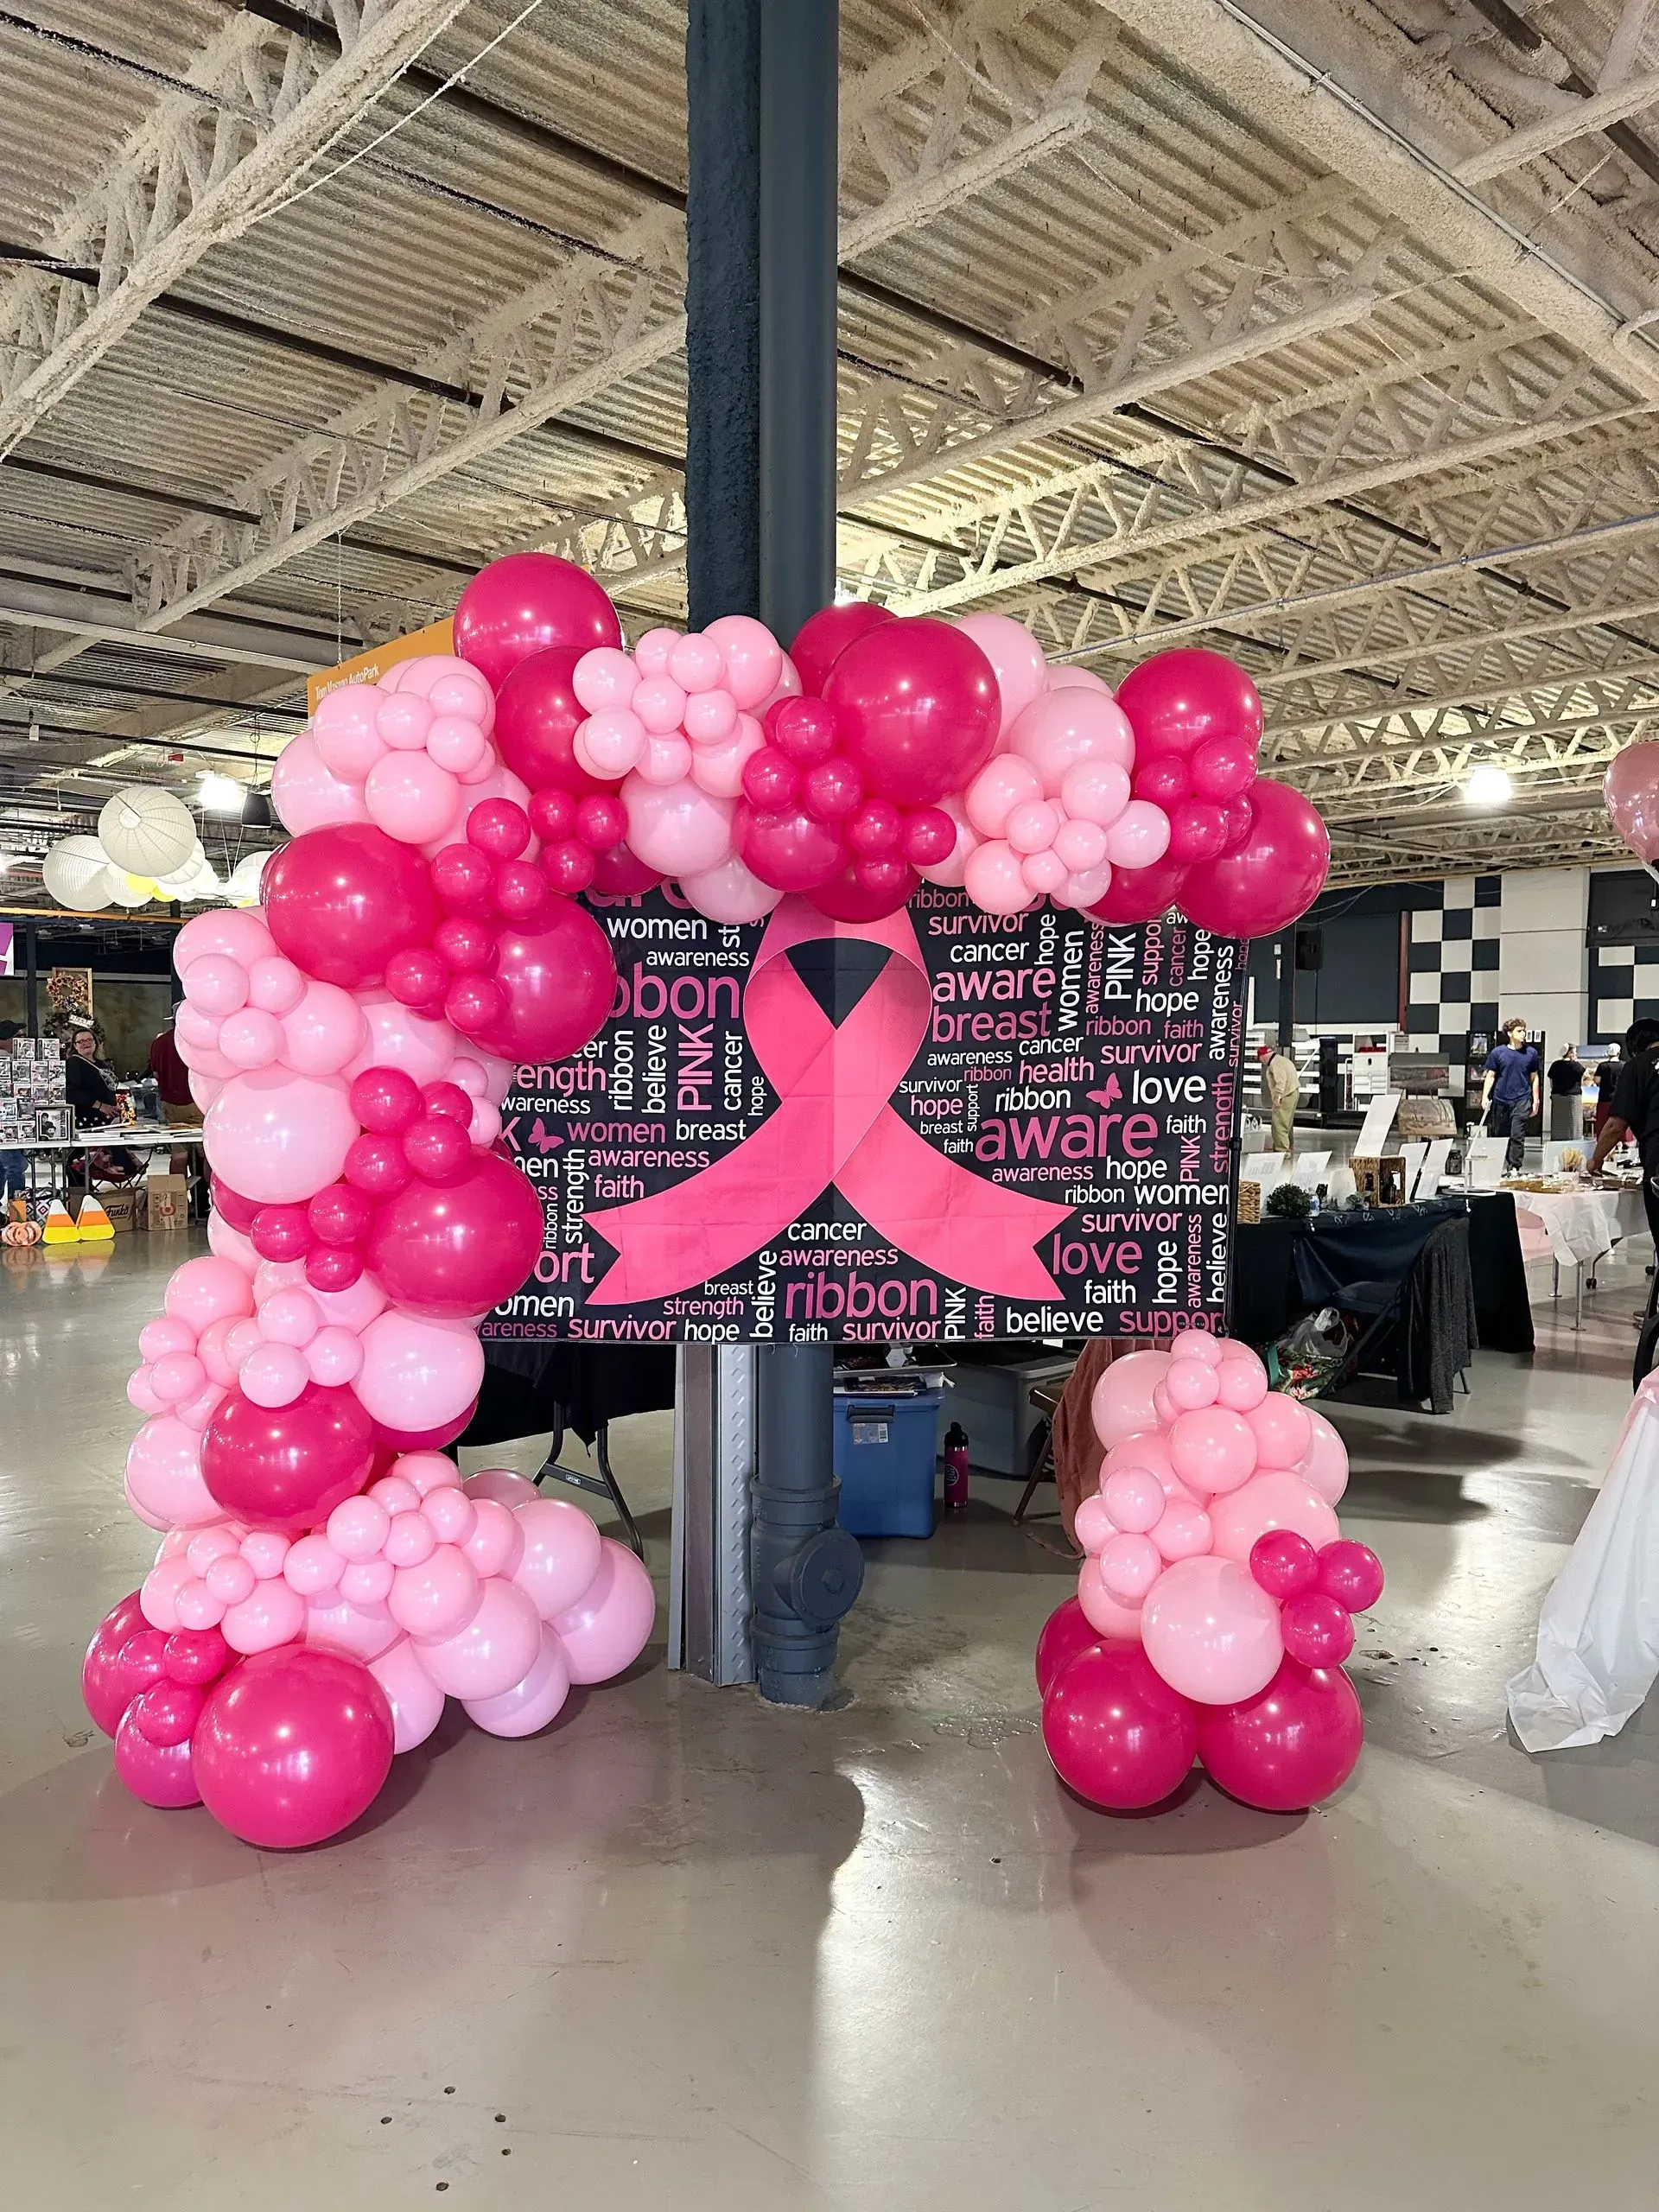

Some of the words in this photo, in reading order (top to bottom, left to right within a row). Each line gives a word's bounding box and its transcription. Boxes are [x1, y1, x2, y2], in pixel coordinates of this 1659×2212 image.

[348, 664, 378, 684] AutoPark
[909, 889, 969, 908] ribbon
[607, 918, 708, 940] women
[928, 913, 1029, 935] survivor
[950, 940, 1029, 963] cancer
[1034, 914, 1059, 965] hope
[646, 950, 750, 967] awareness
[1104, 931, 1137, 1000] PINK
[1169, 926, 1187, 987] cancer
[1187, 929, 1215, 980] hope
[1058, 930, 1084, 1032] women
[1085, 923, 1104, 1014] awareness
[607, 962, 740, 1020] bbon
[932, 966, 1056, 1002] aware
[1135, 988, 1199, 1016] hope
[1209, 945, 1234, 1061] awareness
[932, 1001, 1052, 1043] breast
[1085, 1016, 1151, 1036] ribbon
[1163, 1020, 1204, 1039] faith
[1229, 1001, 1243, 1067] survivor
[927, 1049, 1013, 1066] awareness
[1019, 1037, 1084, 1056] cancer
[1101, 1039, 1203, 1065] survivor
[513, 1060, 607, 1097] ength
[608, 1030, 634, 1109] ribbon
[642, 1025, 667, 1113] believe
[677, 1023, 714, 1111] PINK
[724, 1030, 743, 1111] cancer
[964, 1066, 1011, 1082] ribbon
[1019, 1056, 1094, 1084] health
[748, 1076, 767, 1116] hope
[899, 1077, 963, 1094] survivor
[1132, 1070, 1206, 1104] love
[501, 1097, 591, 1115] wareness
[911, 1095, 963, 1120] hope
[966, 1084, 980, 1132] support
[995, 1085, 1071, 1113] ribbon
[567, 1122, 665, 1143] women
[676, 1119, 747, 1141] breast
[920, 1120, 963, 1135] breast
[1166, 1115, 1206, 1135] faith
[1210, 1071, 1234, 1173] strength
[944, 1138, 973, 1154] faith
[975, 1112, 1158, 1161] aware
[588, 1147, 710, 1168] awareness
[1106, 1155, 1167, 1181] hope
[1180, 1135, 1201, 1182] PINK
[594, 1173, 644, 1198] faith
[992, 1165, 1093, 1182] awareness
[562, 1148, 589, 1244] strength
[1065, 1184, 1125, 1204] ribbon
[1134, 1183, 1229, 1205] women
[543, 1203, 558, 1249] ribbon
[788, 1221, 867, 1241] cancer
[1081, 1208, 1182, 1233] survivor
[779, 1246, 899, 1266] awareness
[1052, 1232, 1142, 1276] love
[1187, 1214, 1203, 1308] awareness
[1206, 1211, 1227, 1303] believe
[1153, 1240, 1183, 1305] hope
[704, 1281, 753, 1296] breast
[749, 1249, 777, 1338] believe
[785, 1272, 937, 1320] ribbon
[1084, 1280, 1136, 1305] faith
[495, 1295, 574, 1318] omen
[664, 1297, 743, 1320] strength
[944, 1287, 967, 1340] PINK
[975, 1296, 995, 1339] faith
[1006, 1306, 1104, 1333] believe
[474, 1321, 557, 1337] areness
[568, 1314, 677, 1340] survivor
[683, 1319, 740, 1344] hope
[789, 1322, 828, 1342] faith
[842, 1318, 940, 1340] survivor
